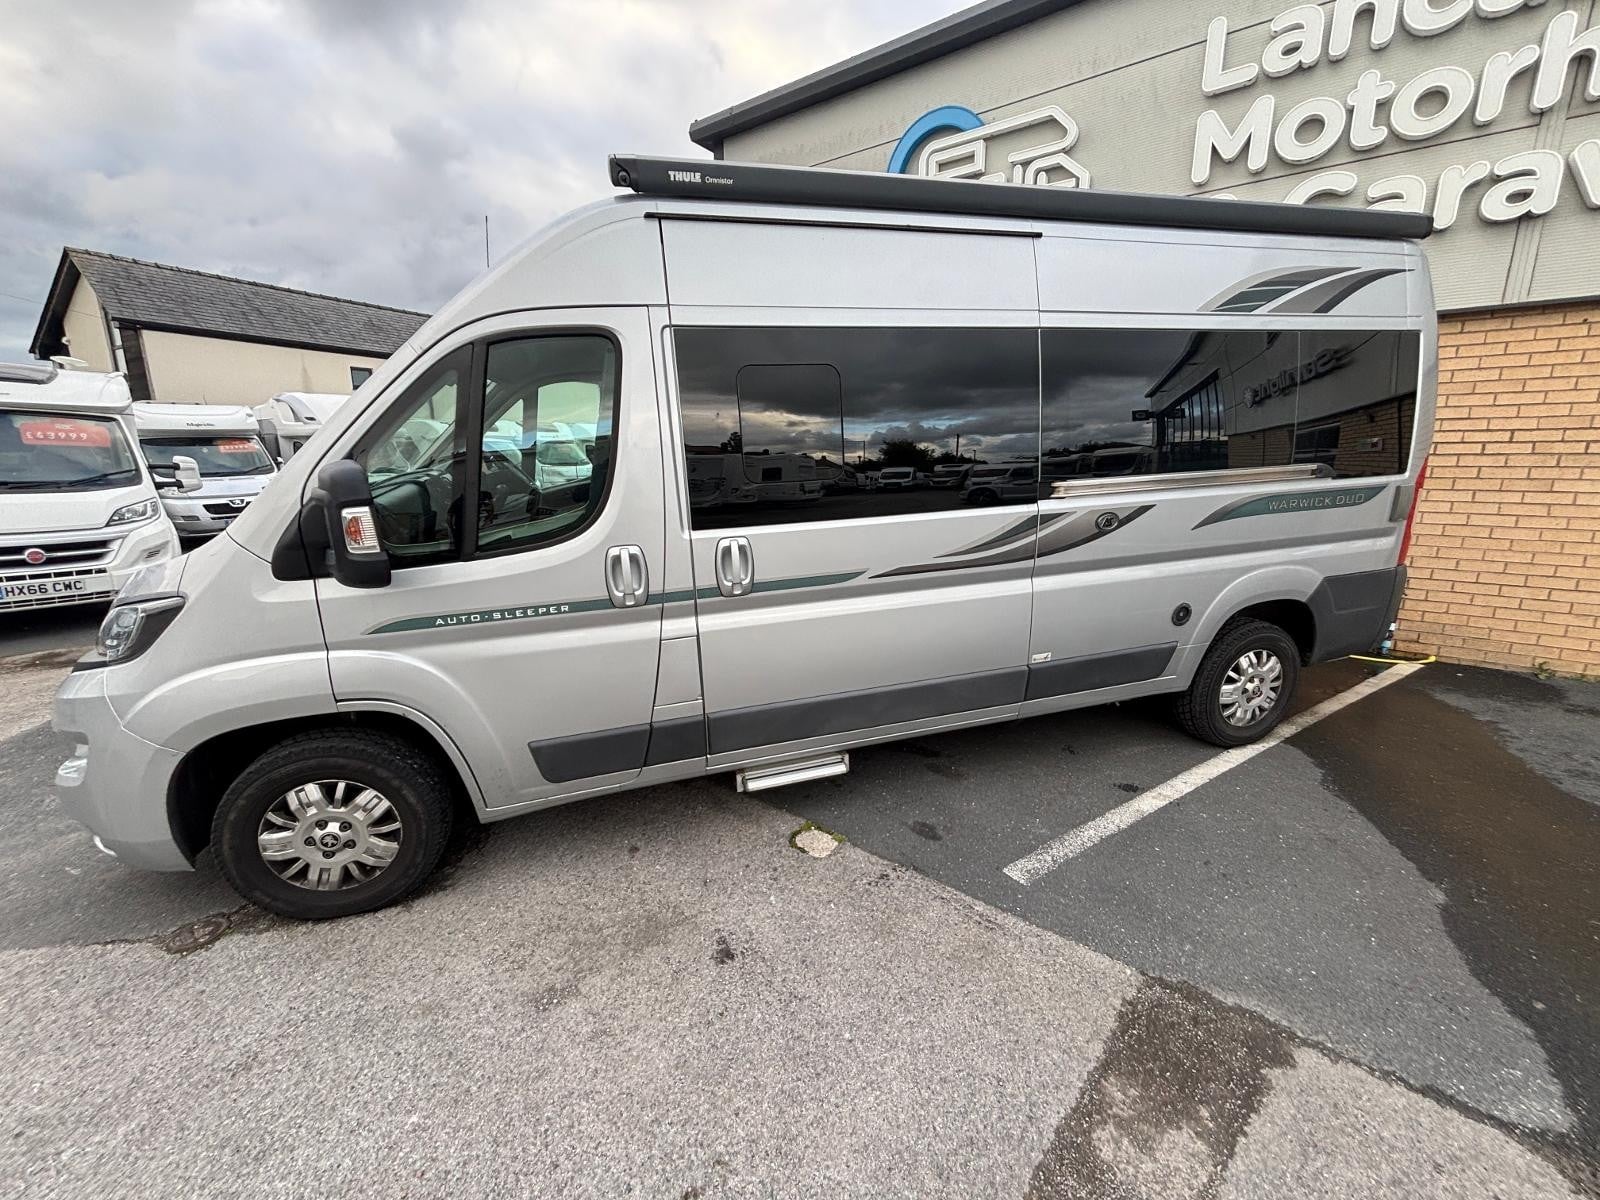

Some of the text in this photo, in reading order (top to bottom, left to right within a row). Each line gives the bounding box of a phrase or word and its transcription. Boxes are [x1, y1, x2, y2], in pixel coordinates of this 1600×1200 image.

[1191, 10, 1600, 186] Motorh
[668, 171, 734, 185] THULE Omnistor
[1268, 493, 1365, 511] WARWICK DUO
[4, 580, 83, 597] HX66 CWC
